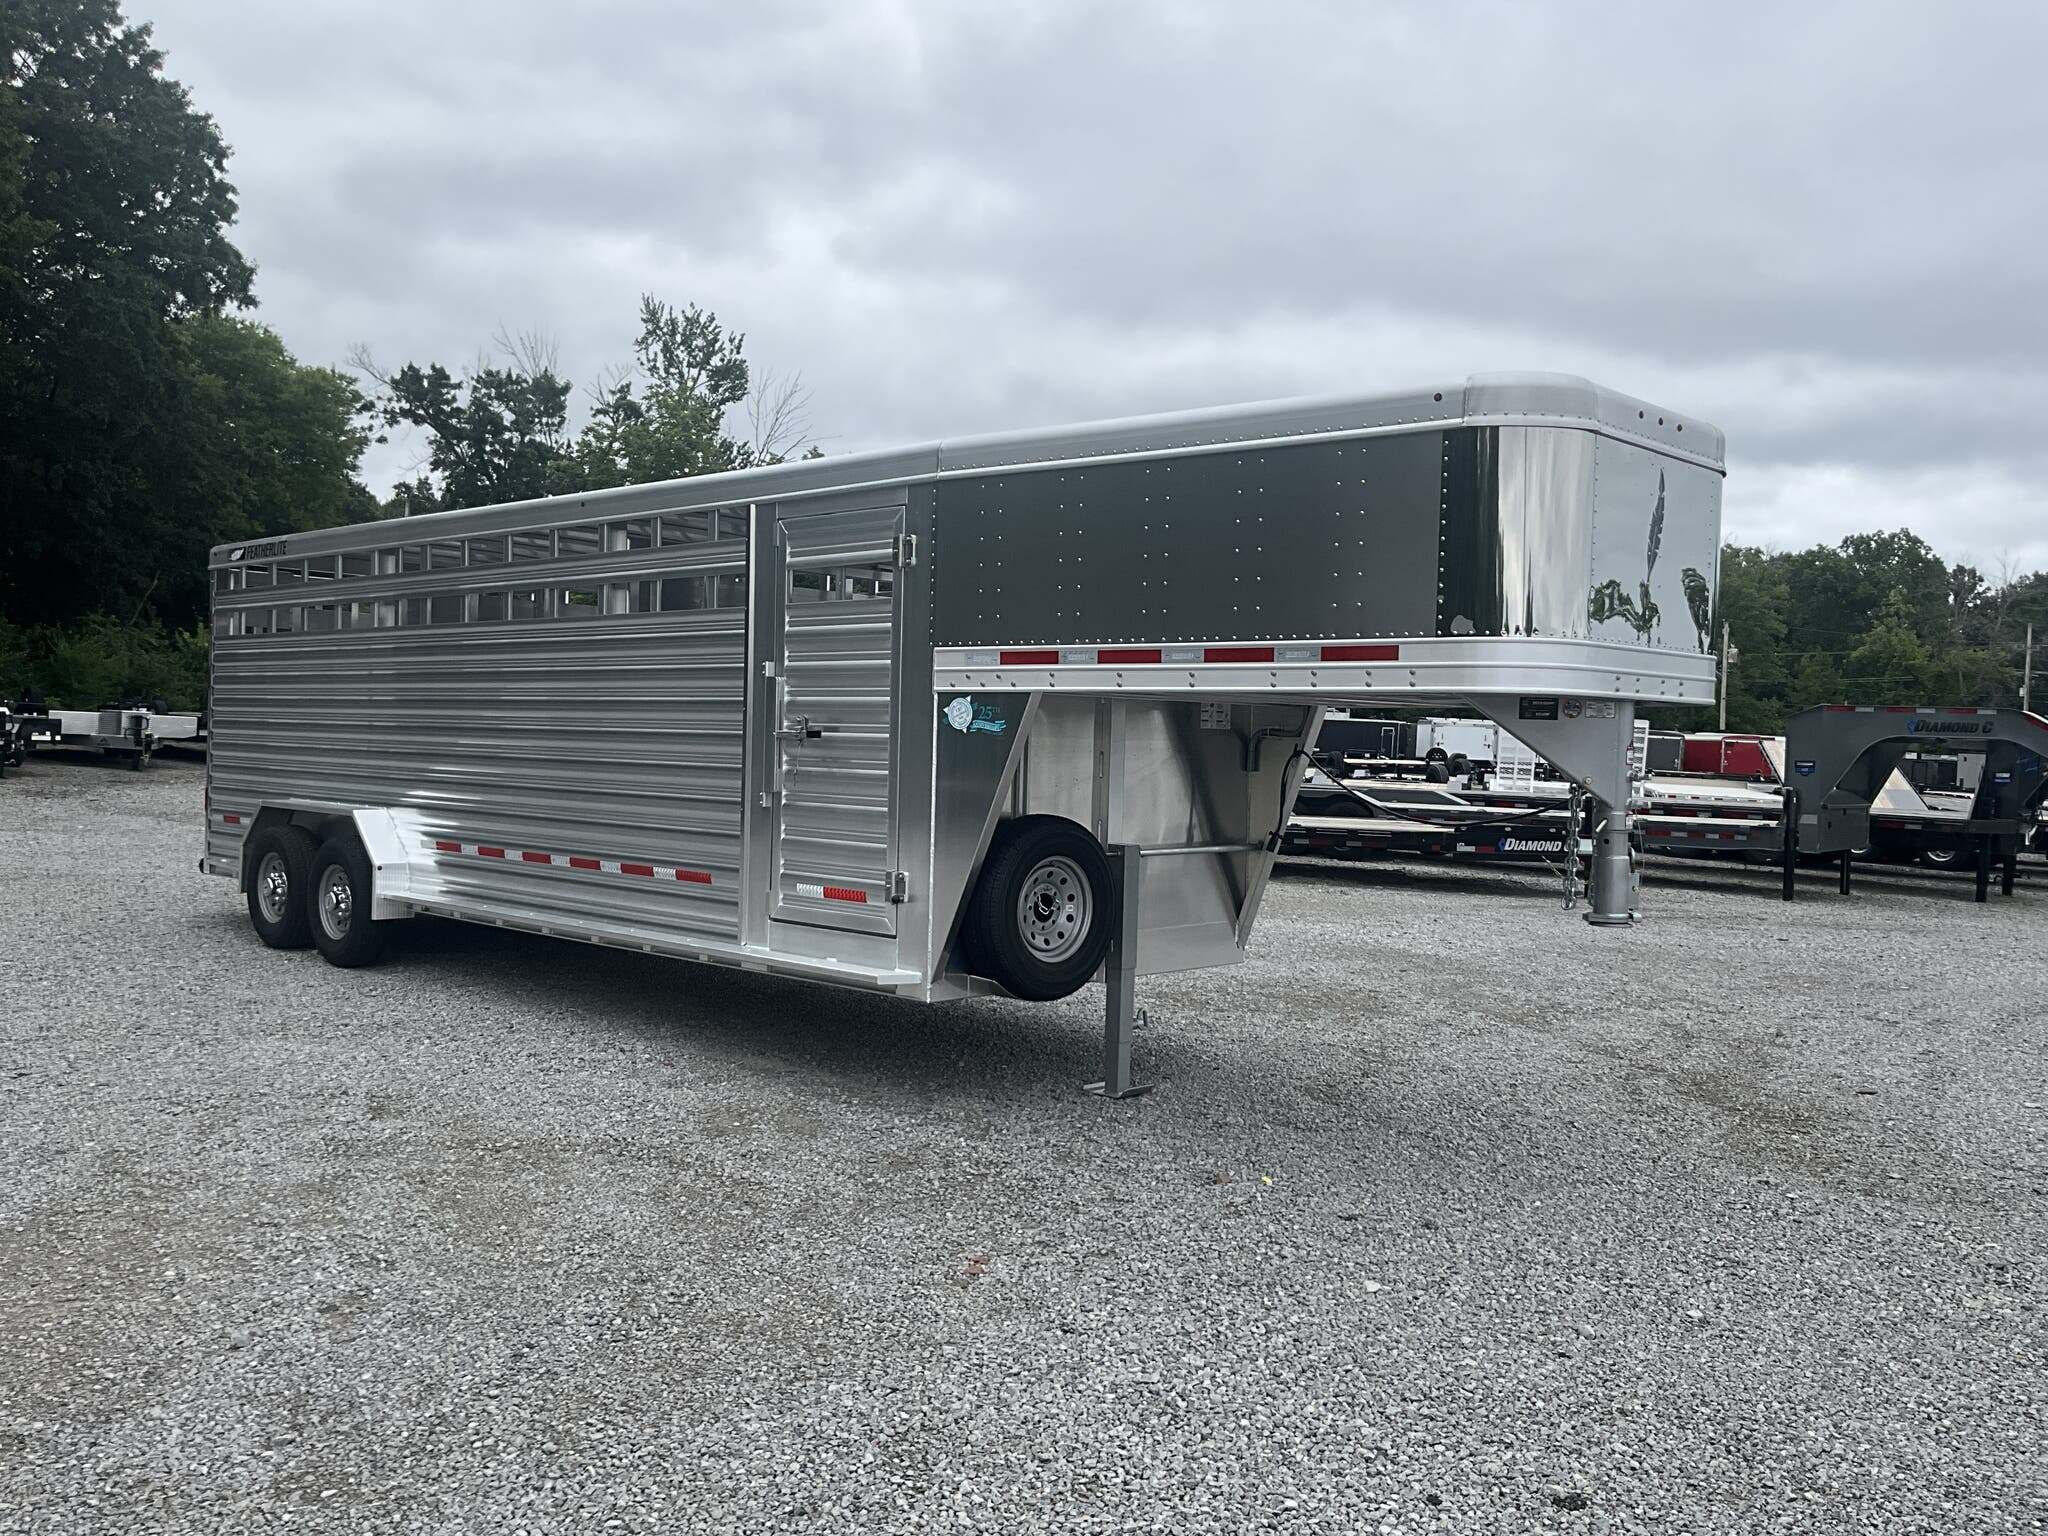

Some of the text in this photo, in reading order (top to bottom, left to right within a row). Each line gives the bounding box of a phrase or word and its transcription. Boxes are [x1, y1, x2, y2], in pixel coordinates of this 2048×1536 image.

[246, 541, 288, 559] FEATHERLITE
[1916, 720, 1994, 733] DIAMOND C
[1504, 838, 1562, 852] DIAMOND
